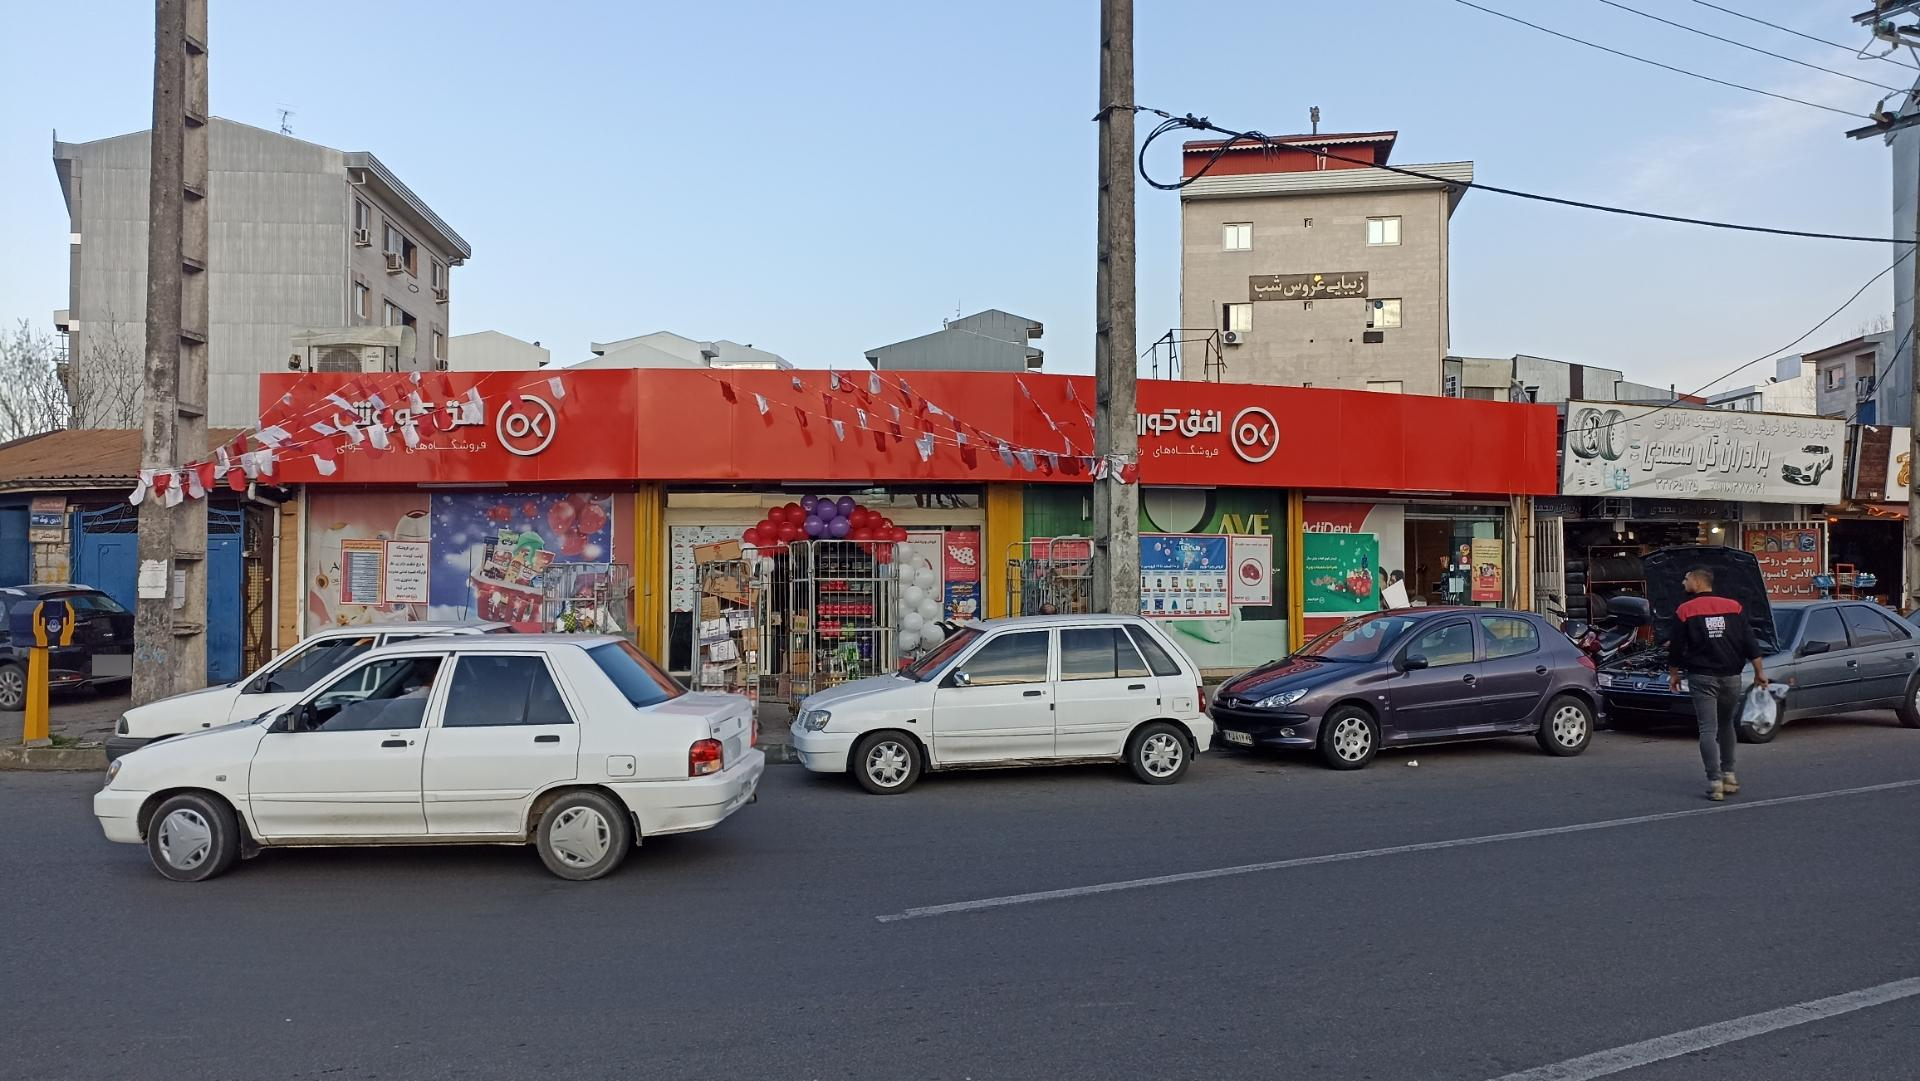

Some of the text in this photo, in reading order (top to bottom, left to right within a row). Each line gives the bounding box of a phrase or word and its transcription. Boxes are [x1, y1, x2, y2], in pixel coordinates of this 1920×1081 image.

[1254, 275, 1364, 298] زیبایی عروس شب
[1179, 408, 1222, 438] افق
[1641, 434, 1771, 478] برادران گل محمدی
[1302, 521, 1352, 533] ActiDent
